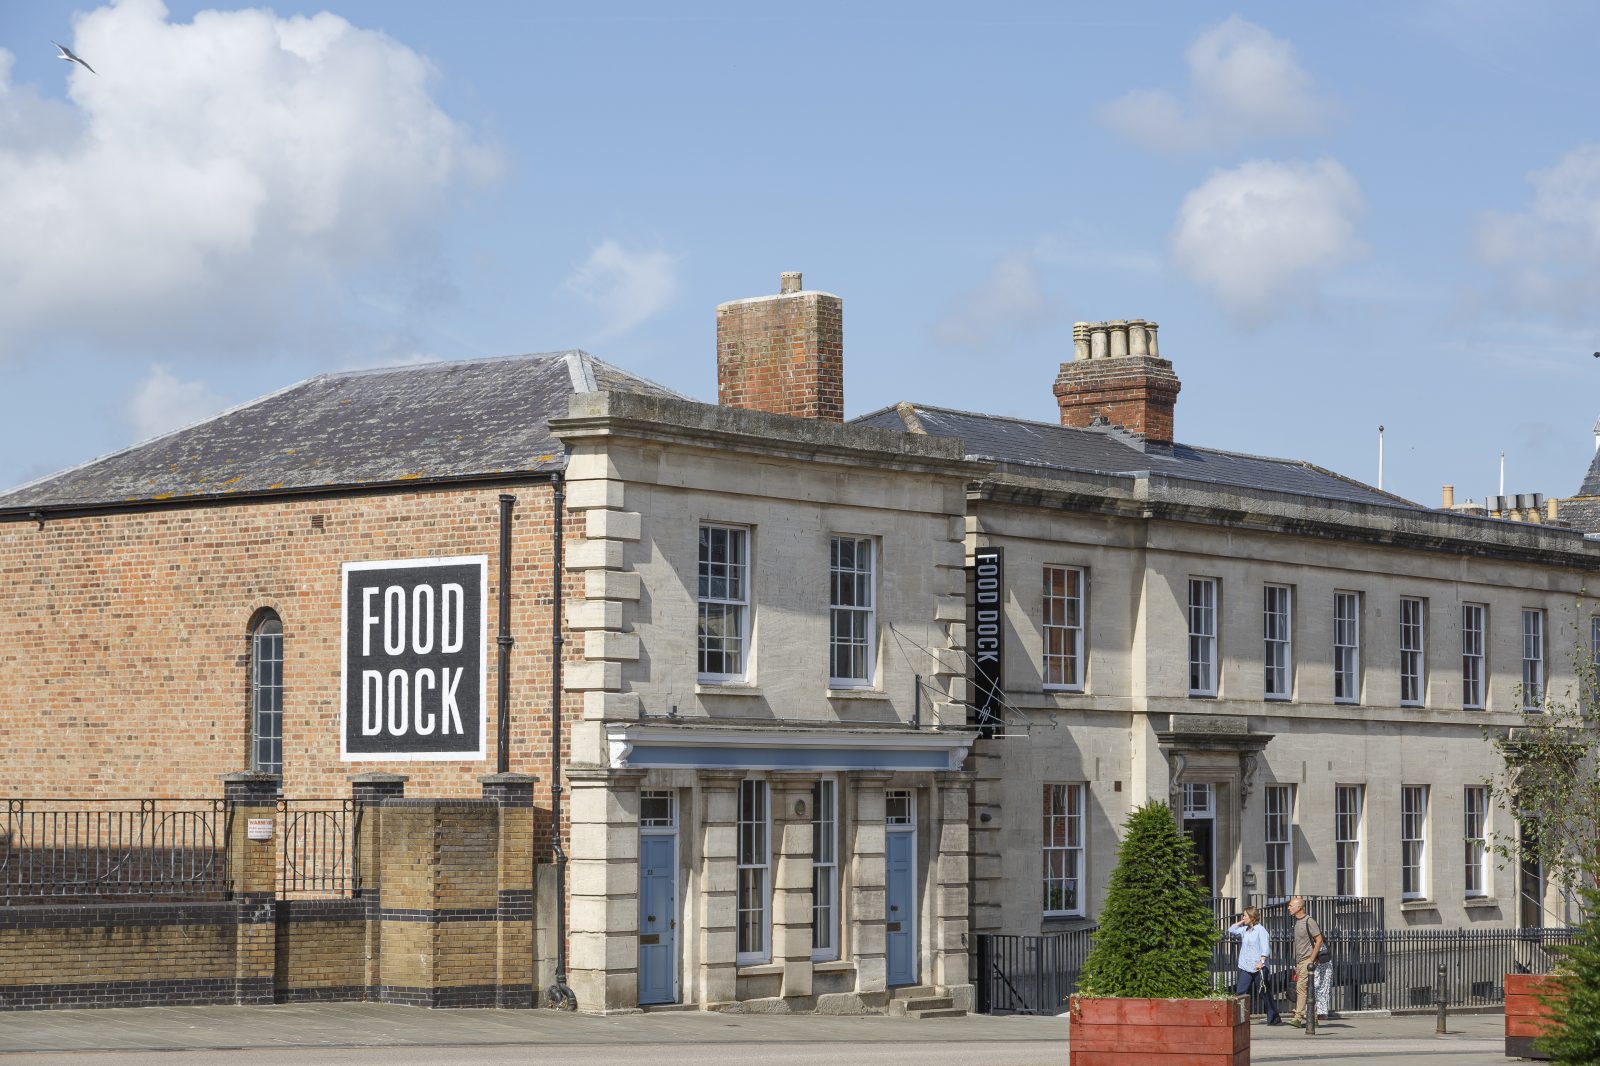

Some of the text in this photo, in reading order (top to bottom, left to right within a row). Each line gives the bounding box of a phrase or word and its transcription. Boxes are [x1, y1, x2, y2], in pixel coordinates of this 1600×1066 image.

[362, 582, 464, 656] FOOD
[977, 553, 998, 663] FOOD DOCK
[362, 666, 464, 736] DOCK
